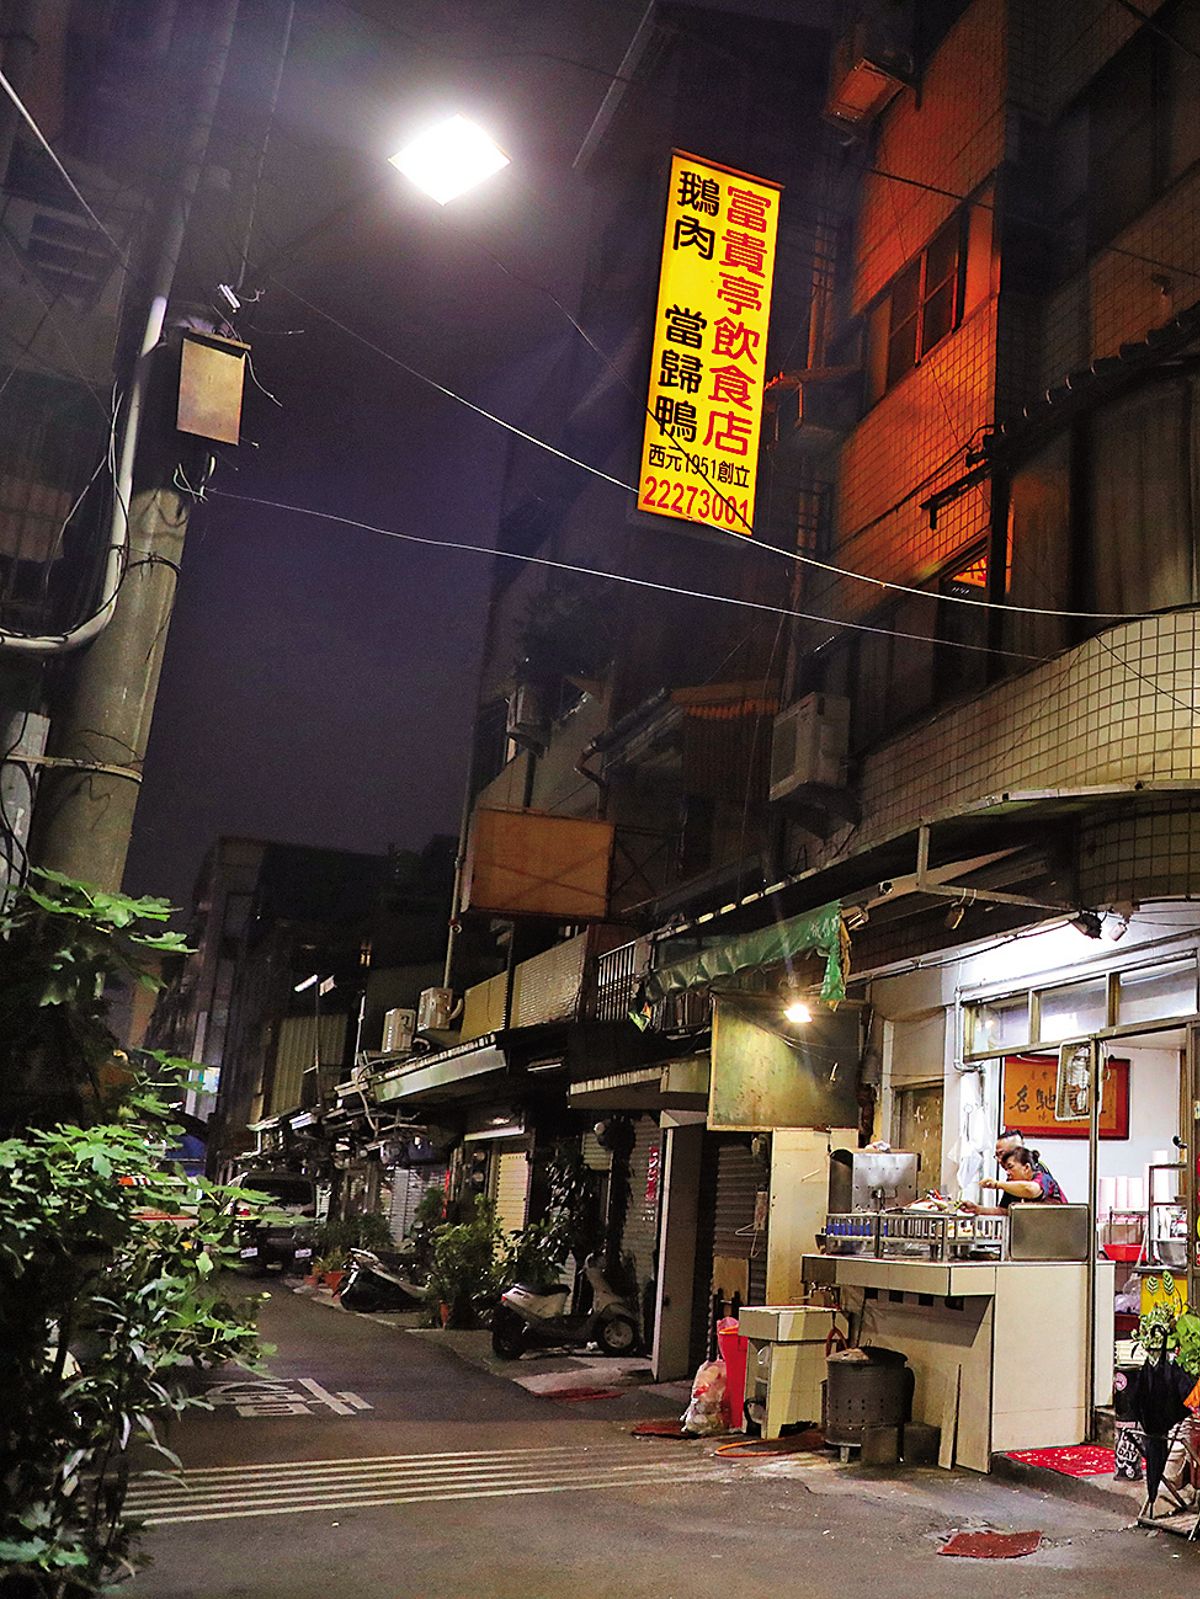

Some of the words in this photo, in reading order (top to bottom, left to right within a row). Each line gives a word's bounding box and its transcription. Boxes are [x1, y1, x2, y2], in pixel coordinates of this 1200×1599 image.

[672, 169, 721, 262] 鵝肉
[702, 185, 772, 457] 富貴亭飲食店
[653, 303, 708, 444] 當歸鴨
[642, 475, 750, 529] 22273001
[647, 442, 751, 490] 西元1951創立
